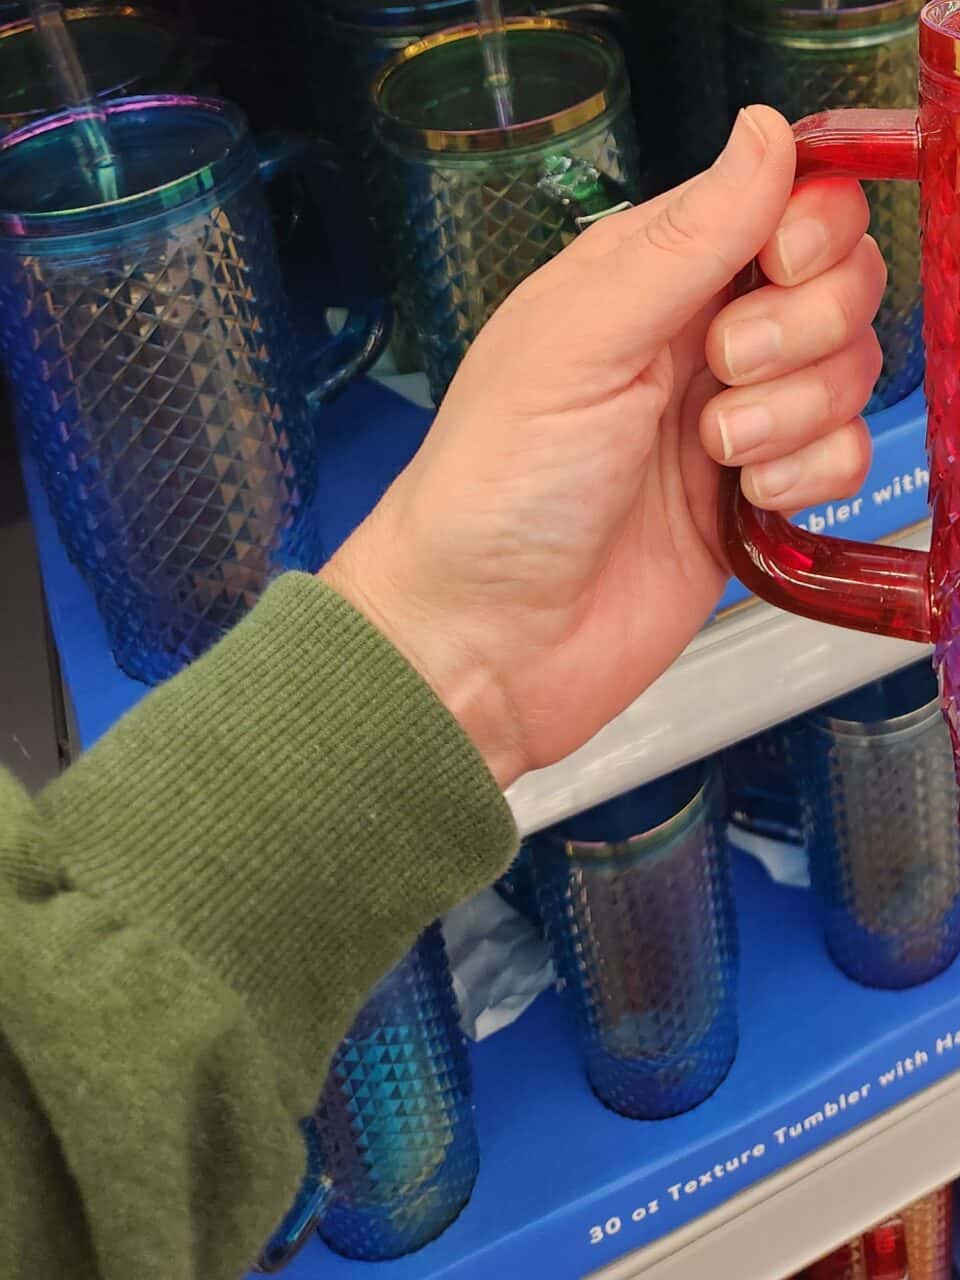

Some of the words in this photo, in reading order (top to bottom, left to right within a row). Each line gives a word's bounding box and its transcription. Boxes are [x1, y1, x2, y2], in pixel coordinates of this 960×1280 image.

[798, 497, 863, 533] bler
[872, 467, 929, 506] with
[589, 1216, 622, 1244] 30
[631, 1199, 659, 1222] oz
[667, 1143, 766, 1201] Texture
[773, 1083, 871, 1144] Tumbler
[878, 1050, 929, 1086] with
